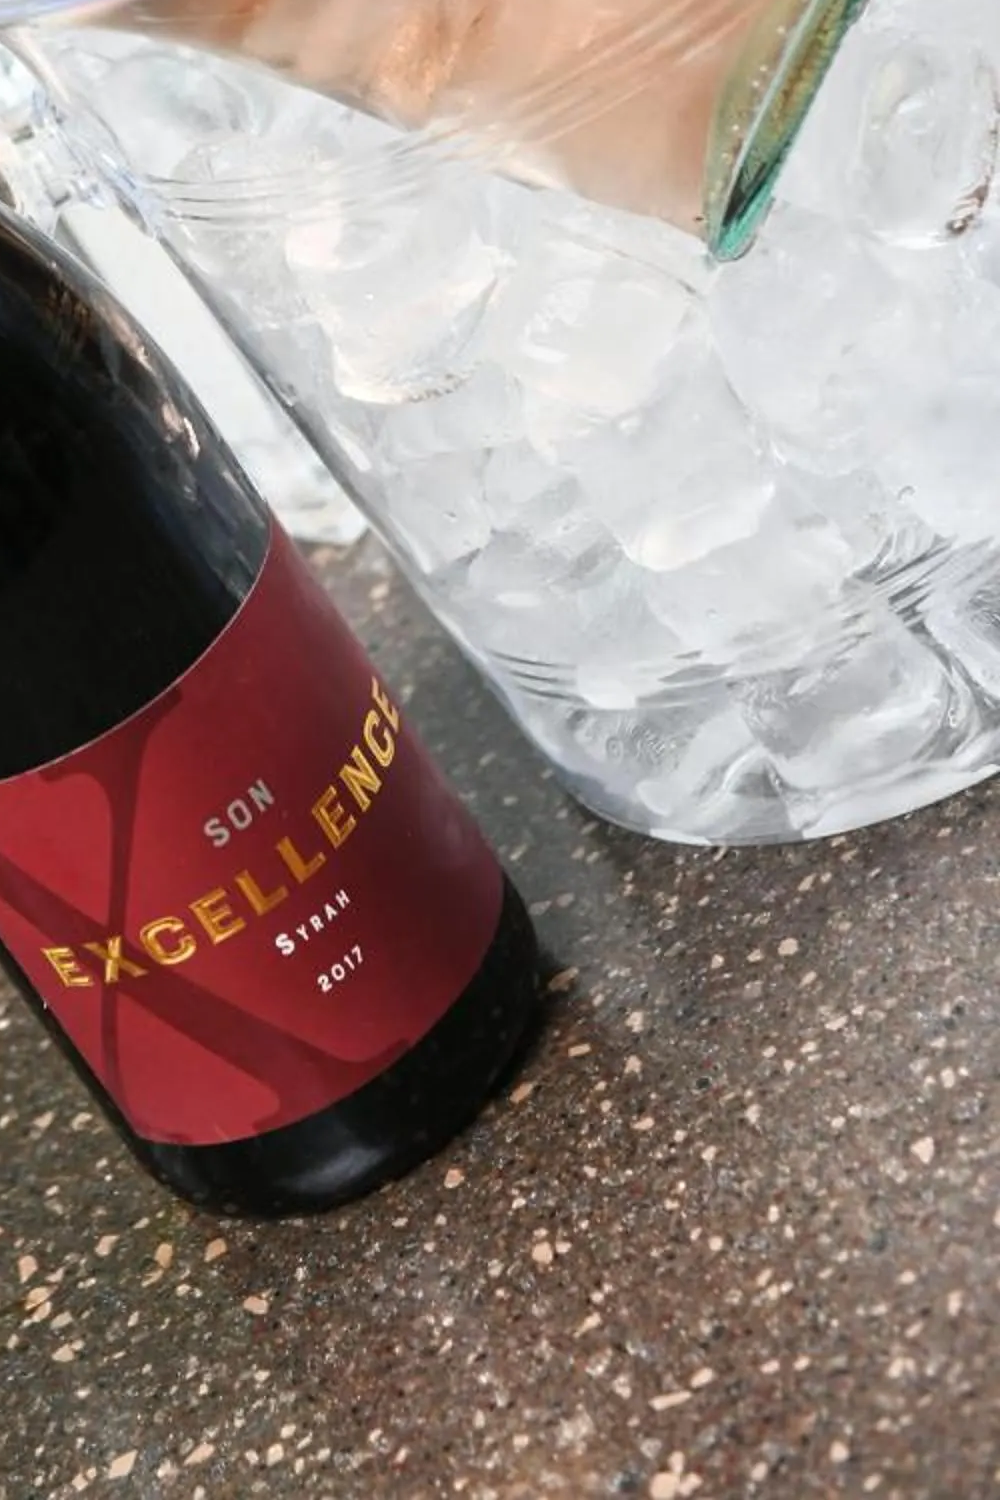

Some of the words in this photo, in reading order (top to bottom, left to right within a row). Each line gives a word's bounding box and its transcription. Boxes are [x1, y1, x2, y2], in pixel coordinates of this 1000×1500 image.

[41, 675, 400, 988] EXCELLENCE
[203, 779, 275, 848] SON
[317, 945, 365, 993] 2017
